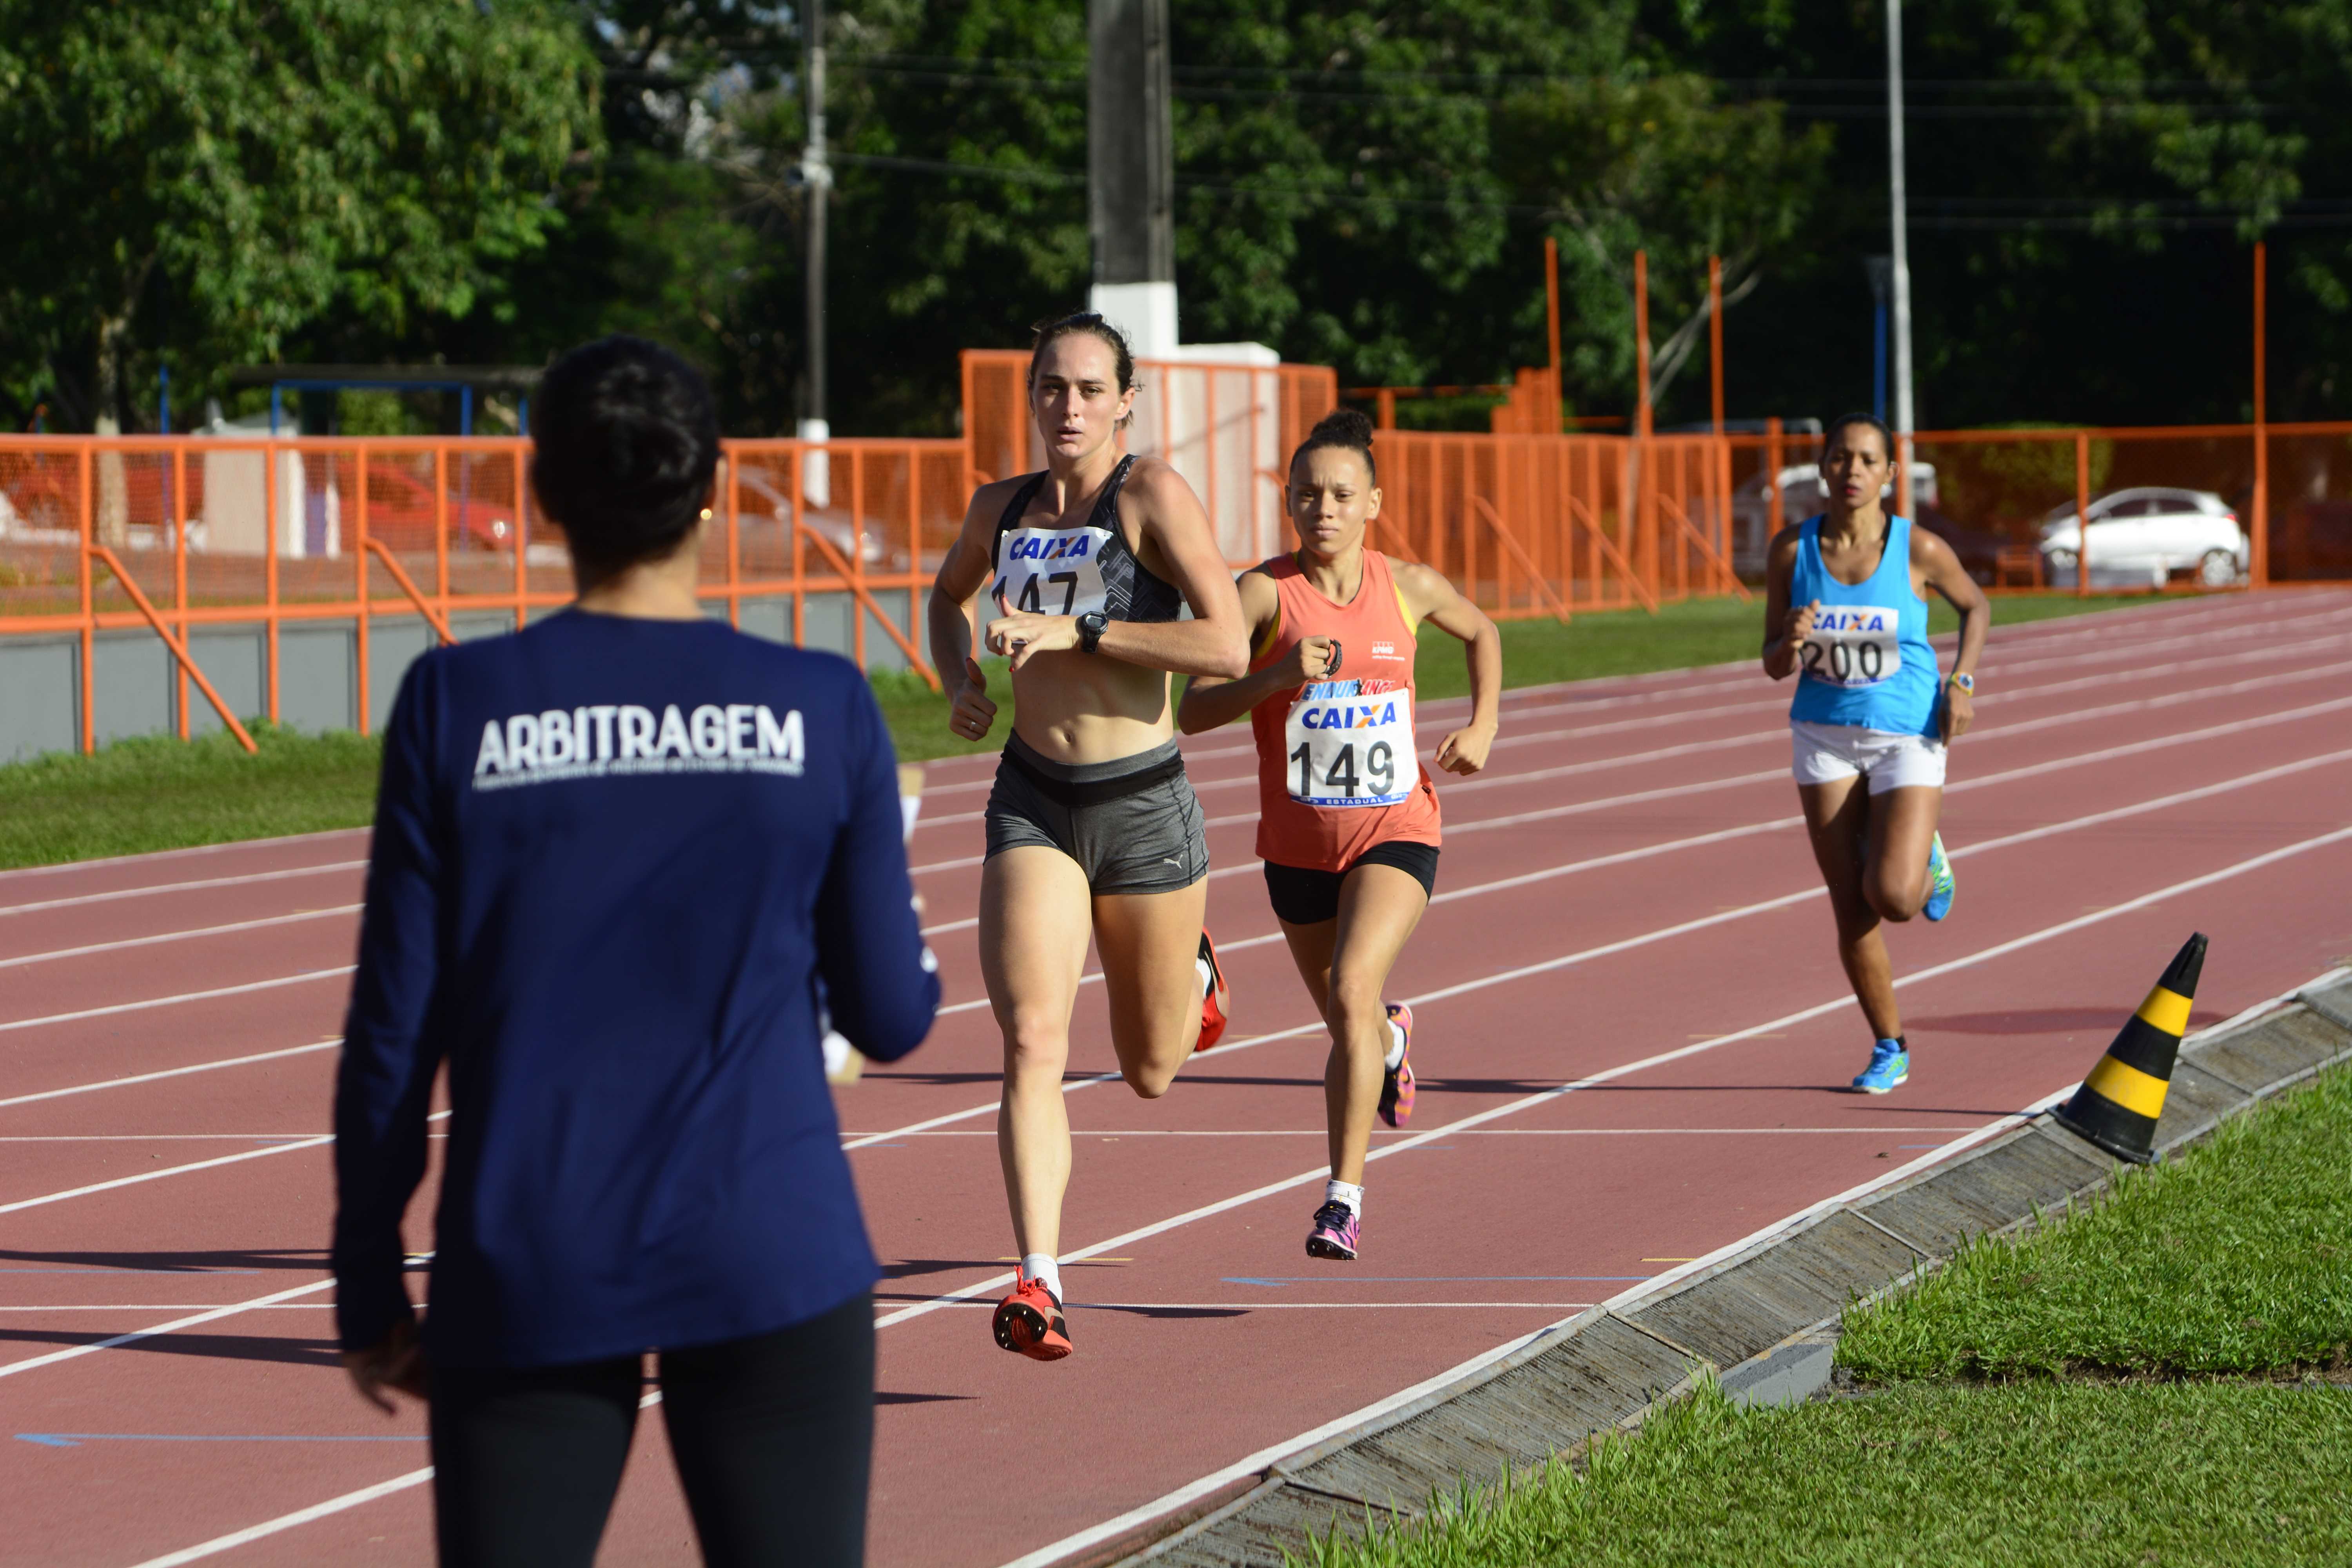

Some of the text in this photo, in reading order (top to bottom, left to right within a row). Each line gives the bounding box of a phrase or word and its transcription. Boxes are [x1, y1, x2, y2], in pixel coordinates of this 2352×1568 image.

[1009, 535, 1089, 561] CAIXA
[1802, 641, 1882, 680] 200
[1302, 702, 1396, 729] CAIXA
[474, 704, 805, 774] ARBITRAGEM
[1291, 741, 1394, 797] 149
